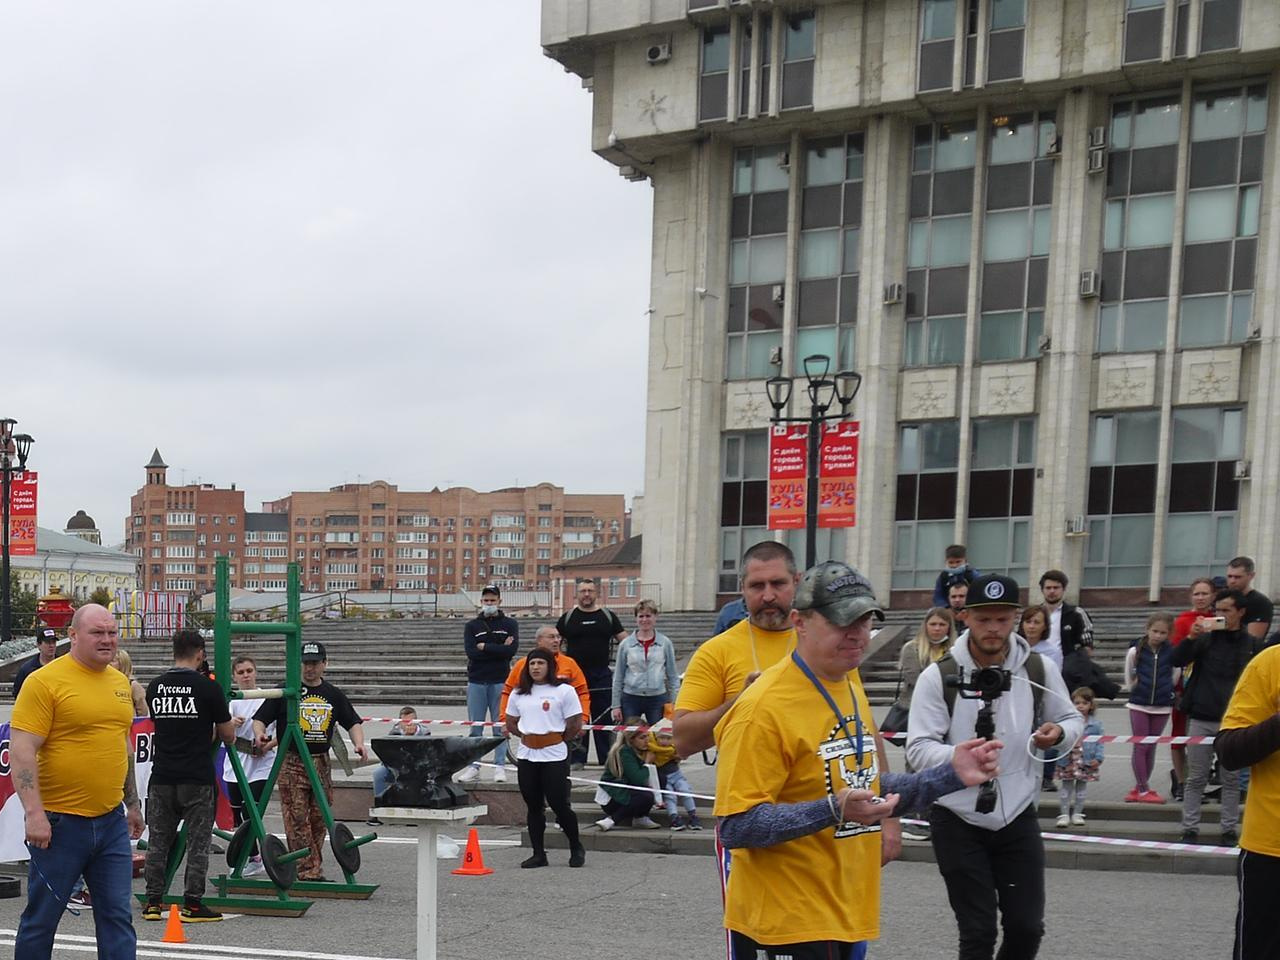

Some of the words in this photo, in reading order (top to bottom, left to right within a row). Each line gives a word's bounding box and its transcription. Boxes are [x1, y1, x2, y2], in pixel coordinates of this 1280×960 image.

[157, 683, 192, 696] Русская
[151, 696, 199, 714] СИЛА
[466, 851, 473, 863] 8
